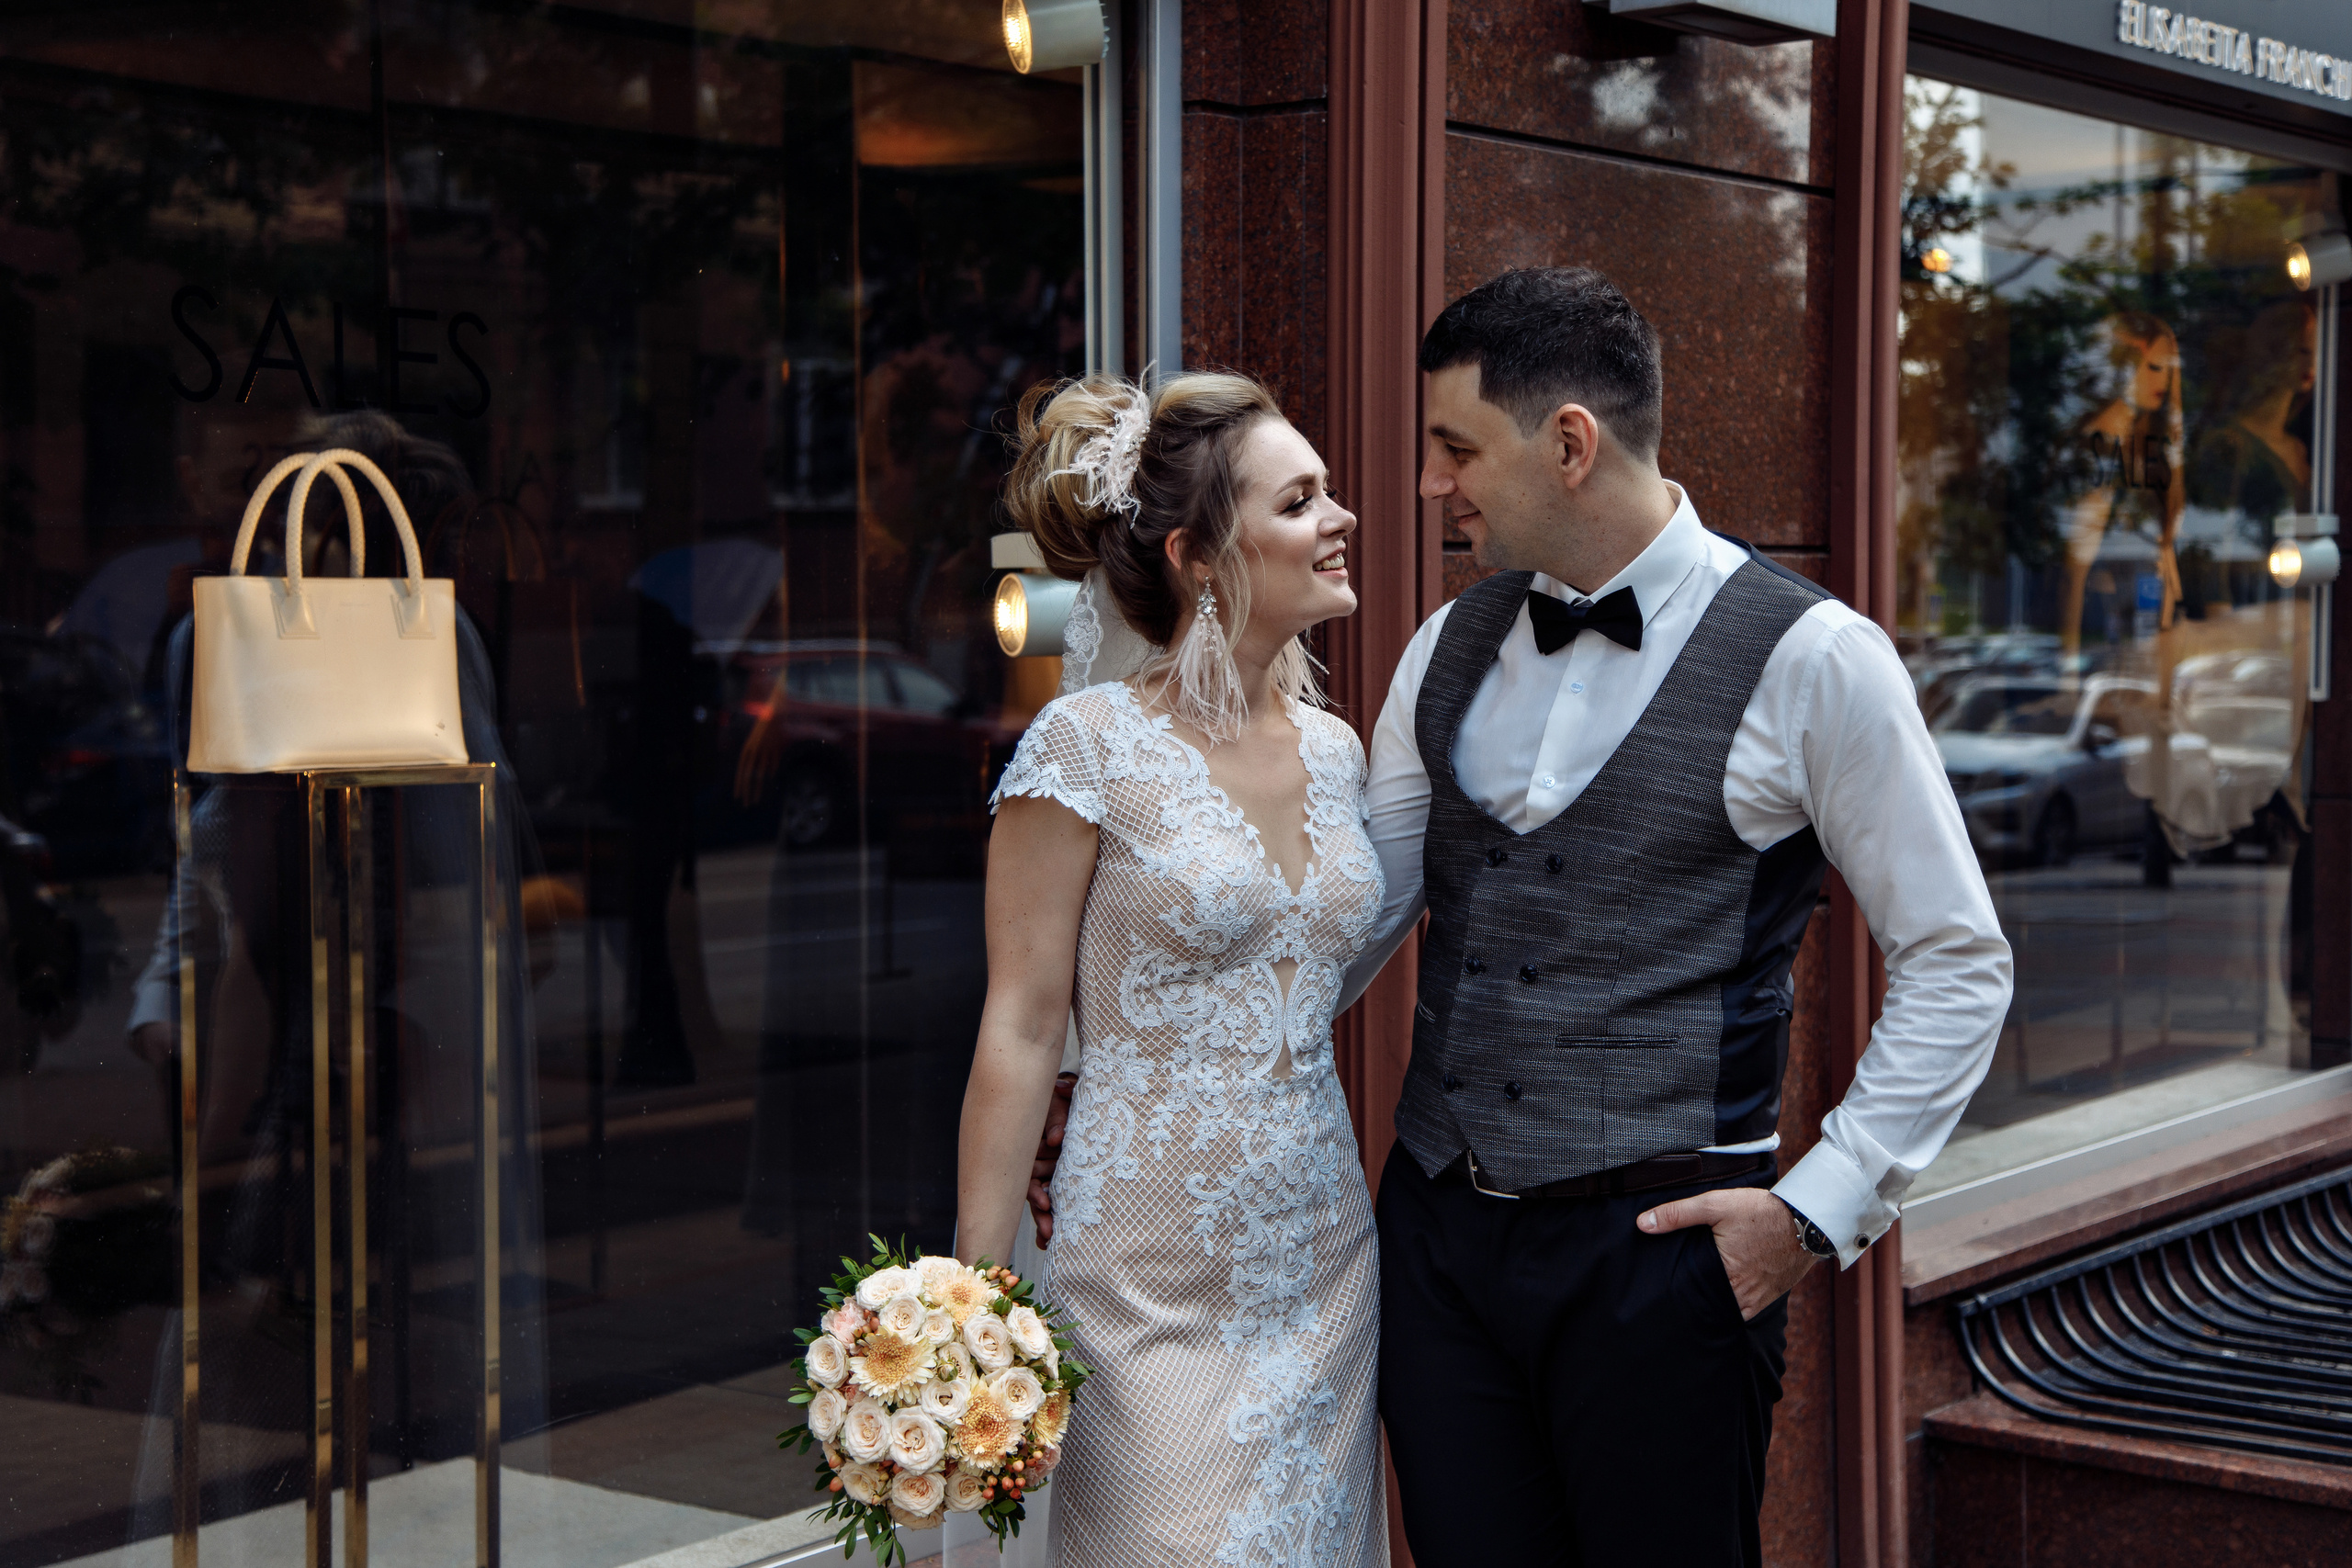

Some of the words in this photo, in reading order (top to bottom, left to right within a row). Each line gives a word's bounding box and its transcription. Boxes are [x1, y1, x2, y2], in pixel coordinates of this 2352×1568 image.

[2120, 0, 2255, 75] ELISABETTA
[168, 285, 491, 421] SALES
[2088, 431, 2172, 491] SALES
